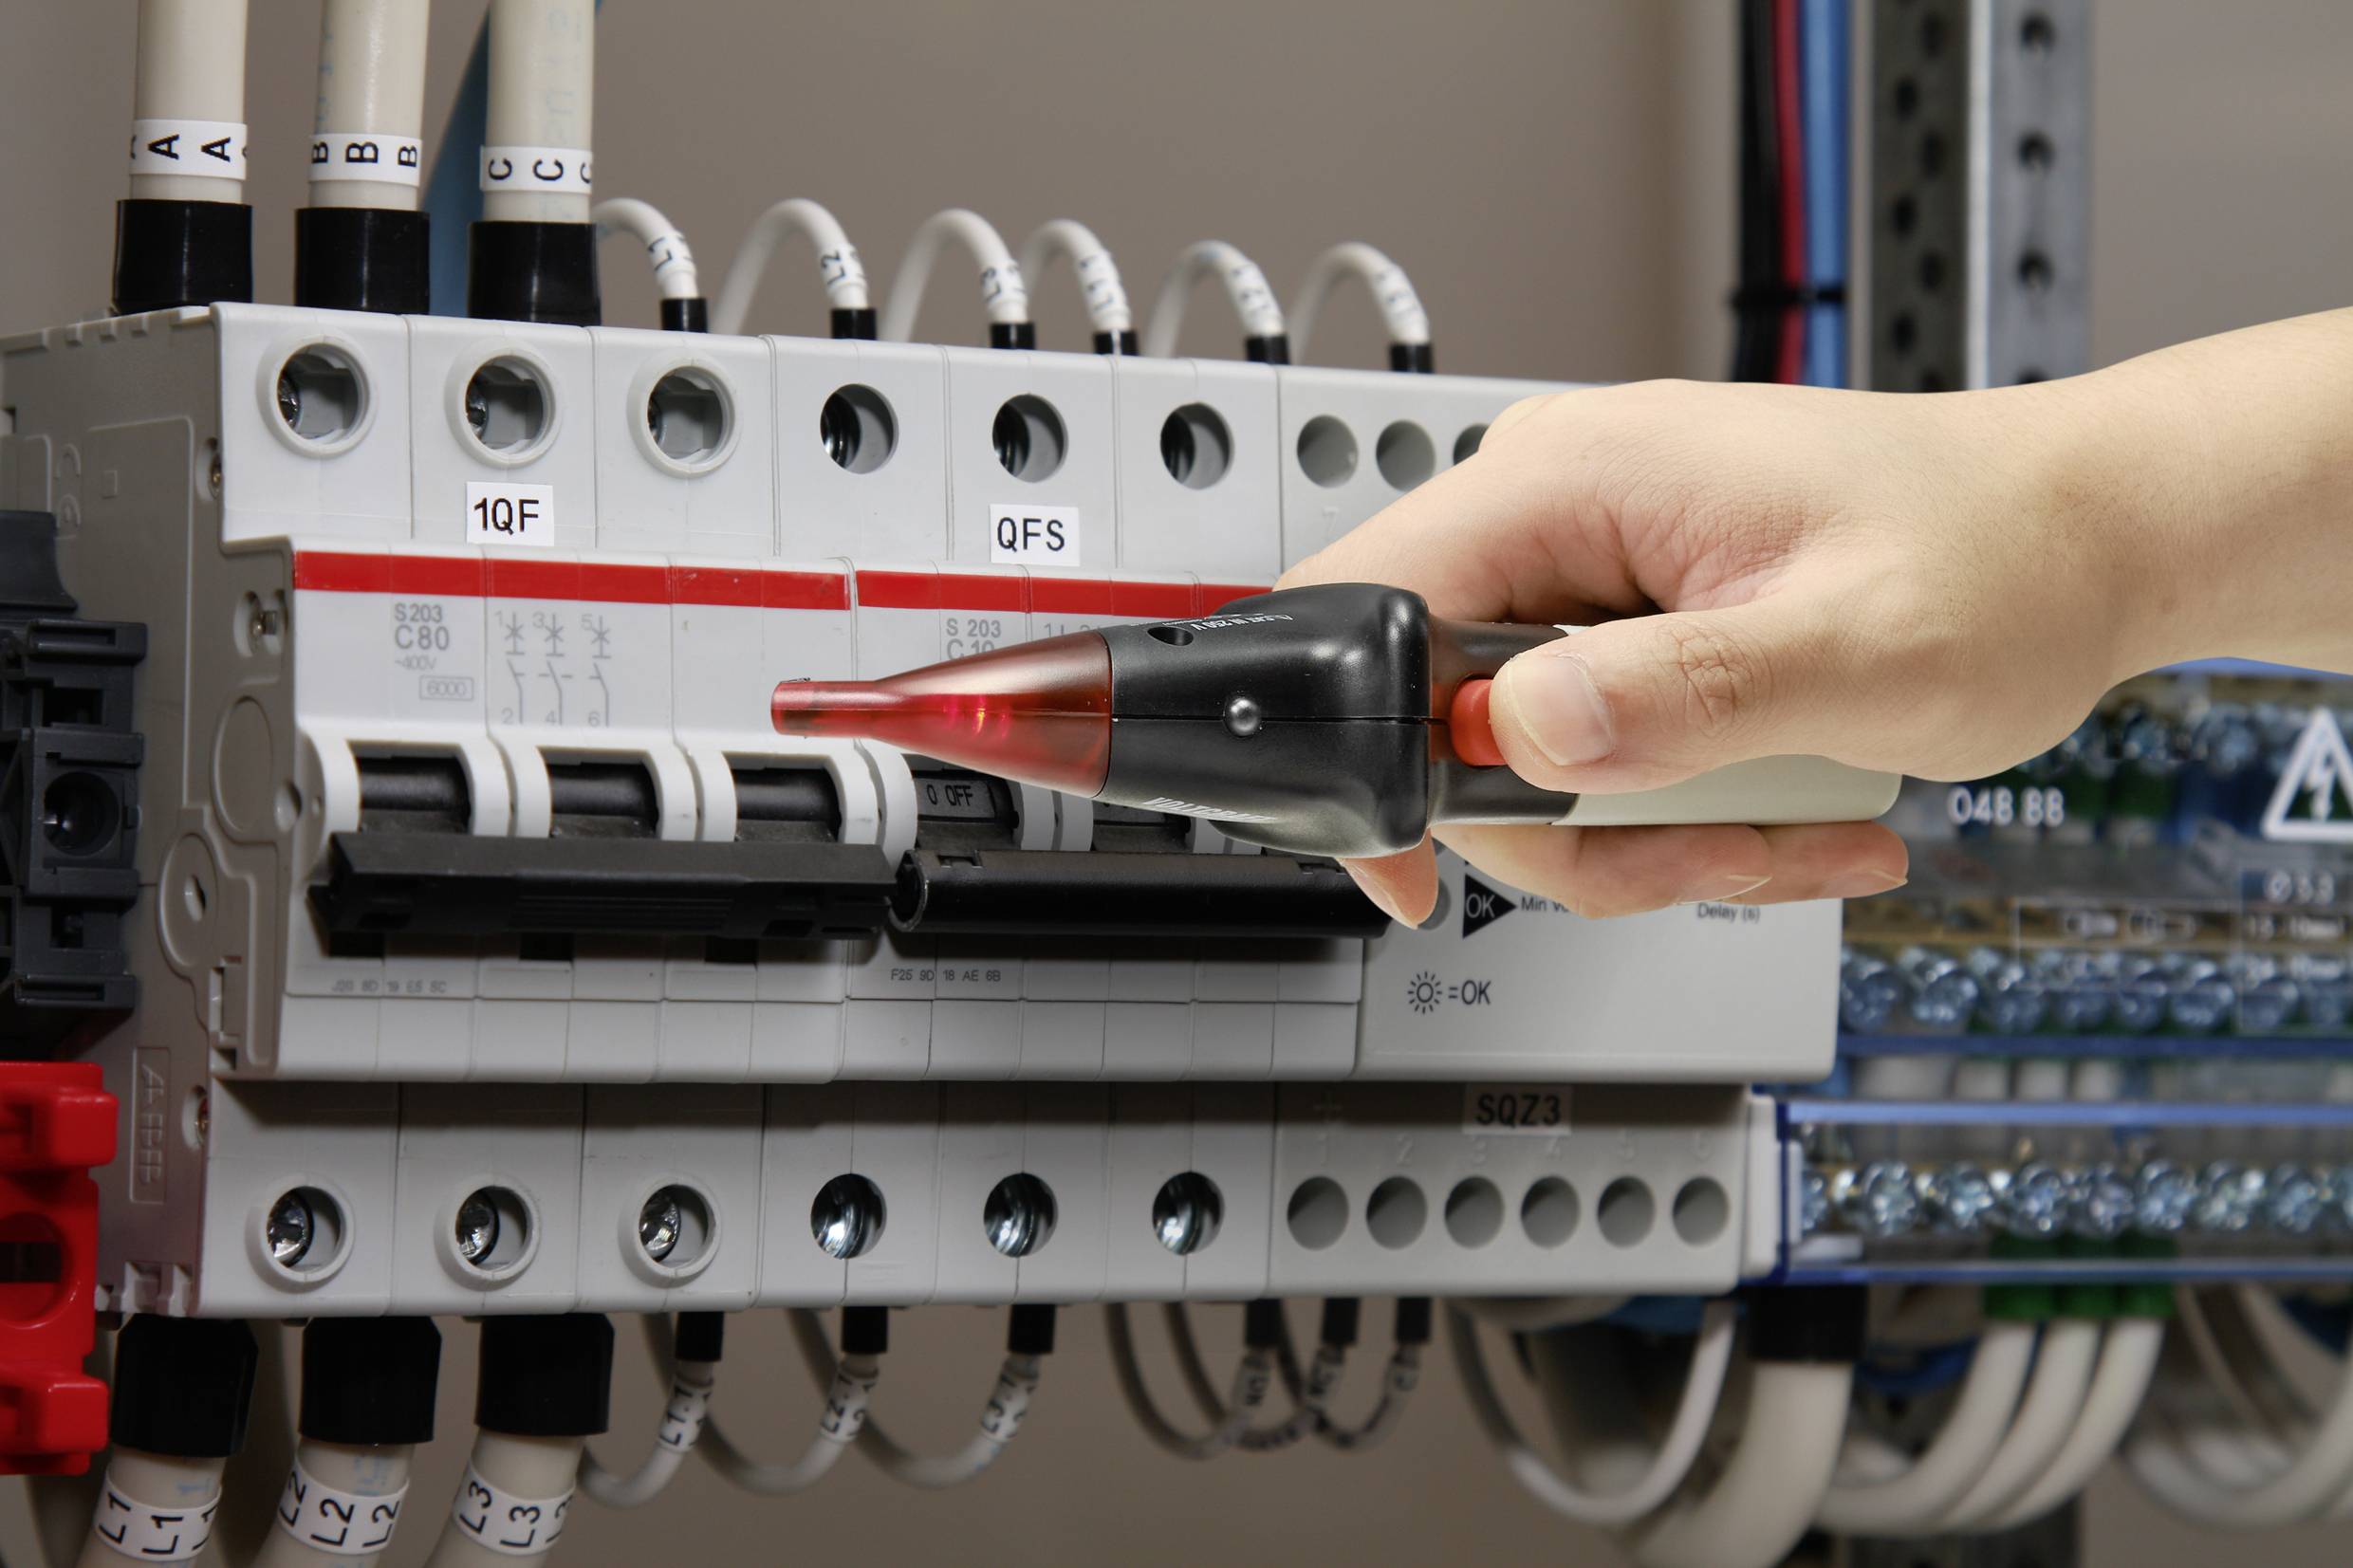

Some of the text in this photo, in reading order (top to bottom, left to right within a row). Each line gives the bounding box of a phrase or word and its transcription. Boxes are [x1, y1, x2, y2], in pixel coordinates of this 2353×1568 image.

[147, 134, 180, 160] A
[200, 137, 232, 162] A
[311, 141, 329, 164] B
[344, 141, 380, 163] B
[398, 145, 417, 168] B
[488, 157, 513, 180] C
[532, 158, 565, 181] C
[473, 497, 540, 536] 1QF
[996, 516, 1065, 553] QFS
[944, 784, 973, 806] OFF
[1465, 893, 1496, 918] OK
[1521, 896, 1547, 912] Min
[1697, 901, 1738, 923] Delay
[943, 968, 955, 982] 18
[962, 969, 980, 983] AE
[1474, 1094, 1563, 1128] SQZ3
[279, 1470, 307, 1527] L2
[458, 1479, 492, 1535] L3
[99, 1491, 131, 1544] L1
[310, 1498, 356, 1547] L2
[361, 1500, 400, 1548] L2
[499, 1505, 541, 1548] L3
[141, 1514, 184, 1555] L1
